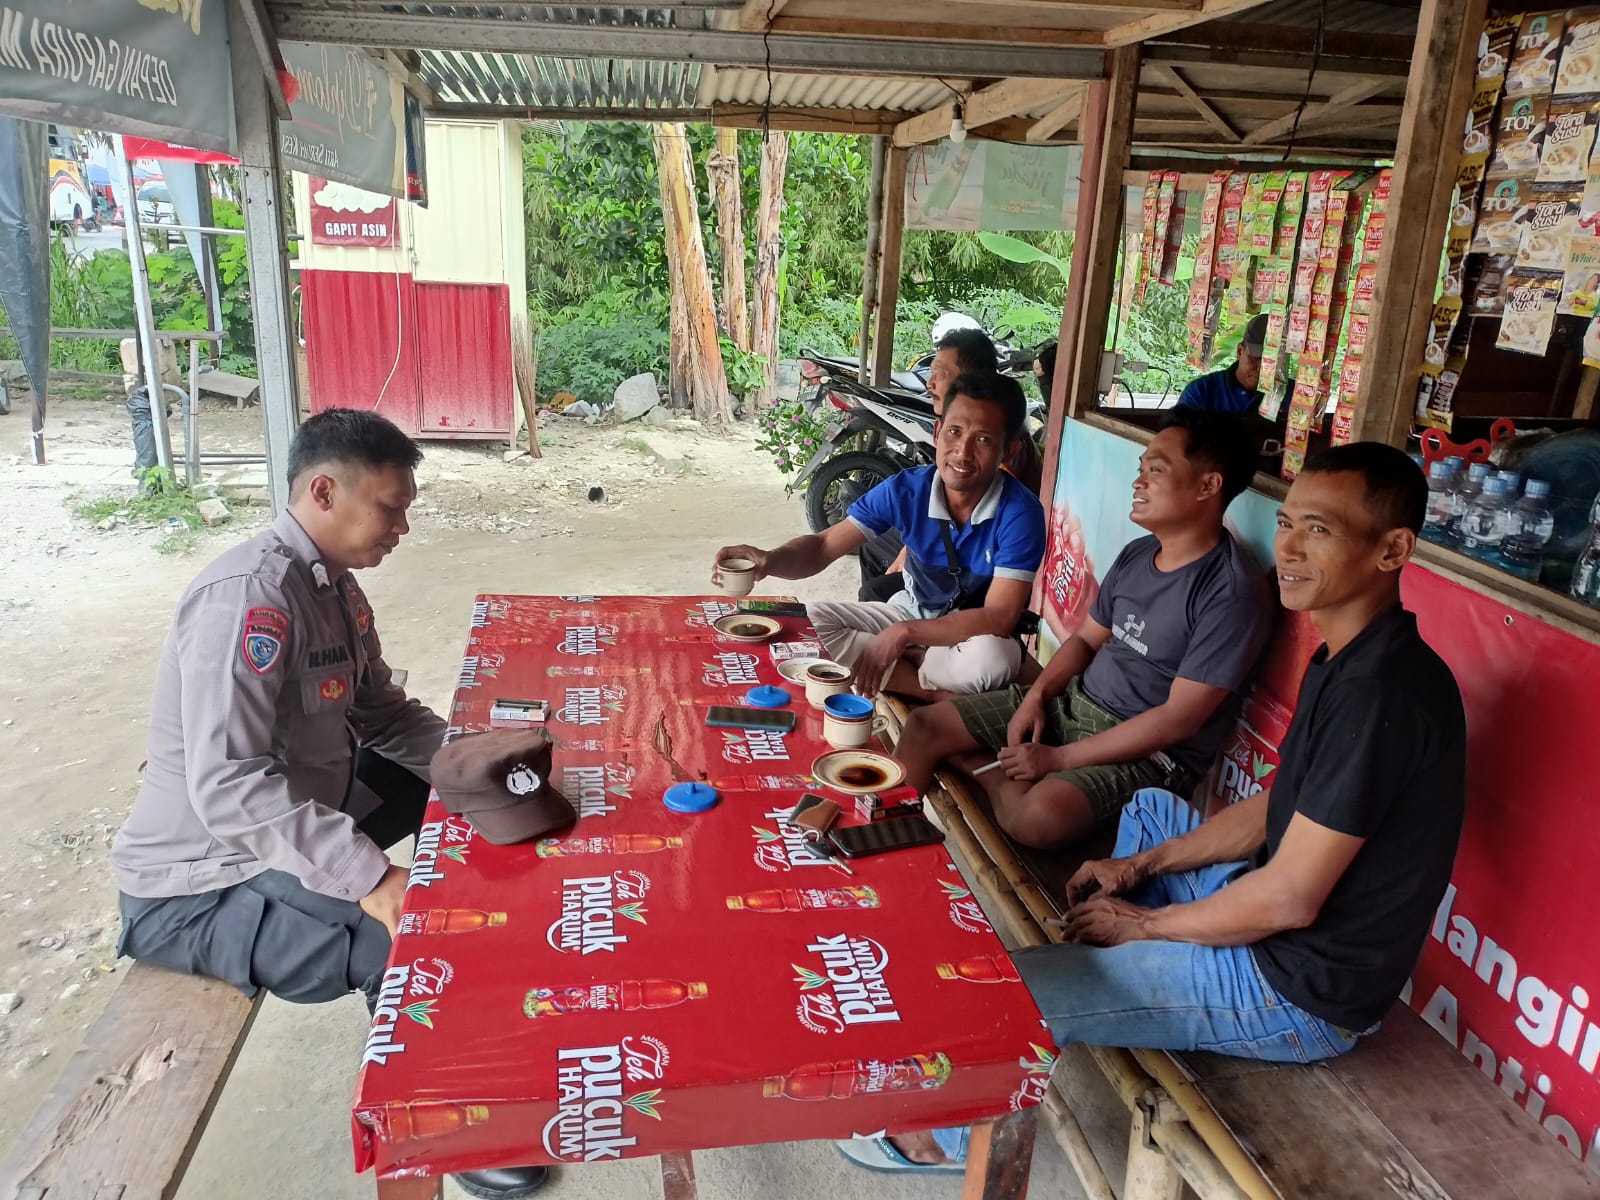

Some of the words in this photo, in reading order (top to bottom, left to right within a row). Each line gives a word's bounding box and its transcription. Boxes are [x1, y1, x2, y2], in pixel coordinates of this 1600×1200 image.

[1504, 116, 1535, 131] TOP
[1554, 112, 1587, 129] Tora
[1536, 202, 1567, 216] Tora
[325, 222, 357, 237] GAPIT
[361, 223, 387, 237] ASIN
[1513, 287, 1544, 302] Tora
[565, 626, 604, 656] pucuk
[712, 651, 760, 685] pucuk
[737, 653, 761, 681] HARUM
[557, 698, 581, 723] HARUM
[565, 687, 610, 726] pucuk
[563, 766, 617, 819] pucuk
[445, 816, 473, 845] Teh
[756, 844, 791, 872] Teh
[613, 870, 648, 900] Teh
[548, 889, 582, 954] HARUM
[561, 875, 629, 956] pucuk
[951, 901, 993, 933] Teh
[412, 957, 444, 998] Teh
[805, 932, 903, 1025] pucuk
[855, 936, 897, 1009] HARUM
[795, 1005, 828, 1035] MINUMAN
[799, 992, 845, 1034] Teh
[621, 1035, 664, 1083] Teh
[639, 1034, 671, 1067] MINUMAN
[866, 1060, 885, 1093] pucuk
[545, 1066, 583, 1161] HARUM
[557, 1045, 638, 1163] pucuk
